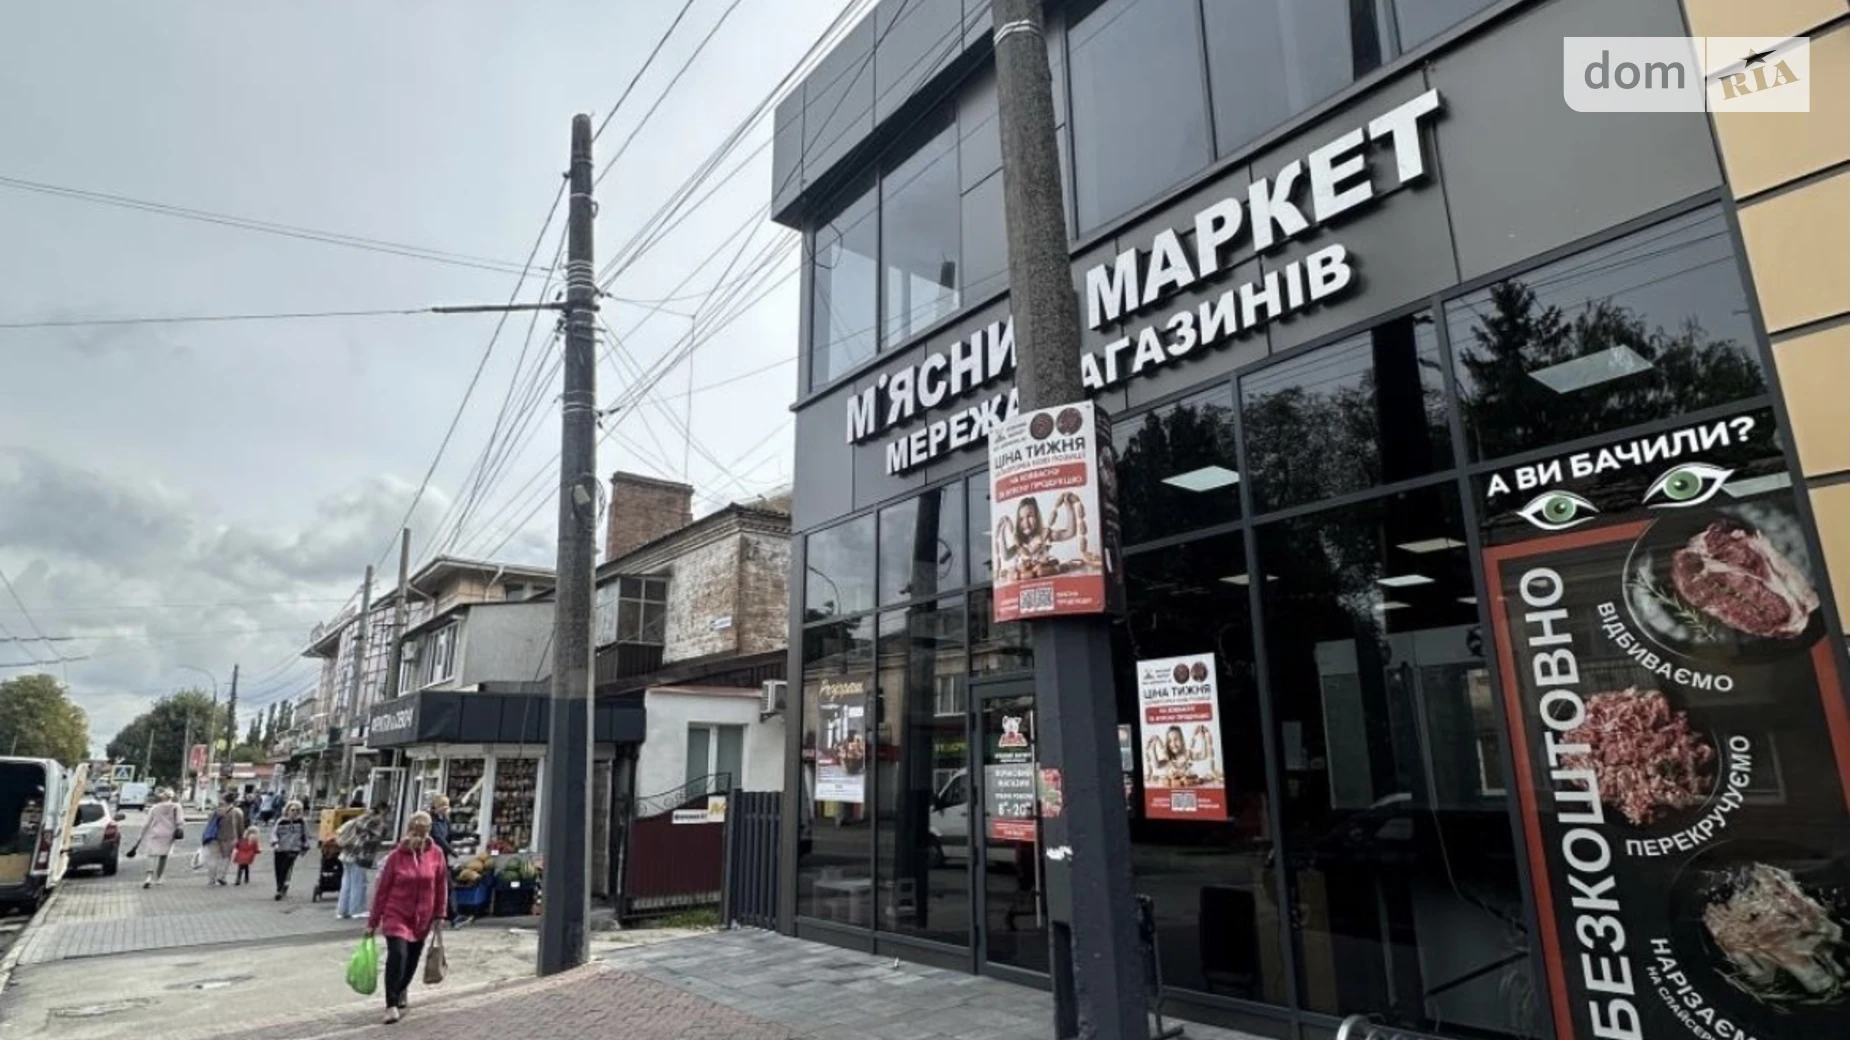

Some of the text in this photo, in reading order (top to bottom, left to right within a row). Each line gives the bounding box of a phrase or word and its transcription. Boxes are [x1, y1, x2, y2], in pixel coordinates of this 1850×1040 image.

[847, 88, 1440, 444] М'ЯСНИ МАРКЕТ
[1080, 243, 1350, 389] АГАЗИНІВ
[1025, 437, 1085, 458] ТИЖНЯ
[1487, 416, 1755, 497] А ВИ БАЧИЛИ?
[1171, 684, 1211, 697] ТИЖНЯ
[1597, 602, 1733, 692] ВІДБИВАЄМО
[1519, 567, 1644, 1040] БЕЗКОШТОВНО
[1626, 735, 1752, 856] ПЕРЕКРУЧУЄМО
[1646, 966, 1716, 1040] НА СЛАЙСЕР
